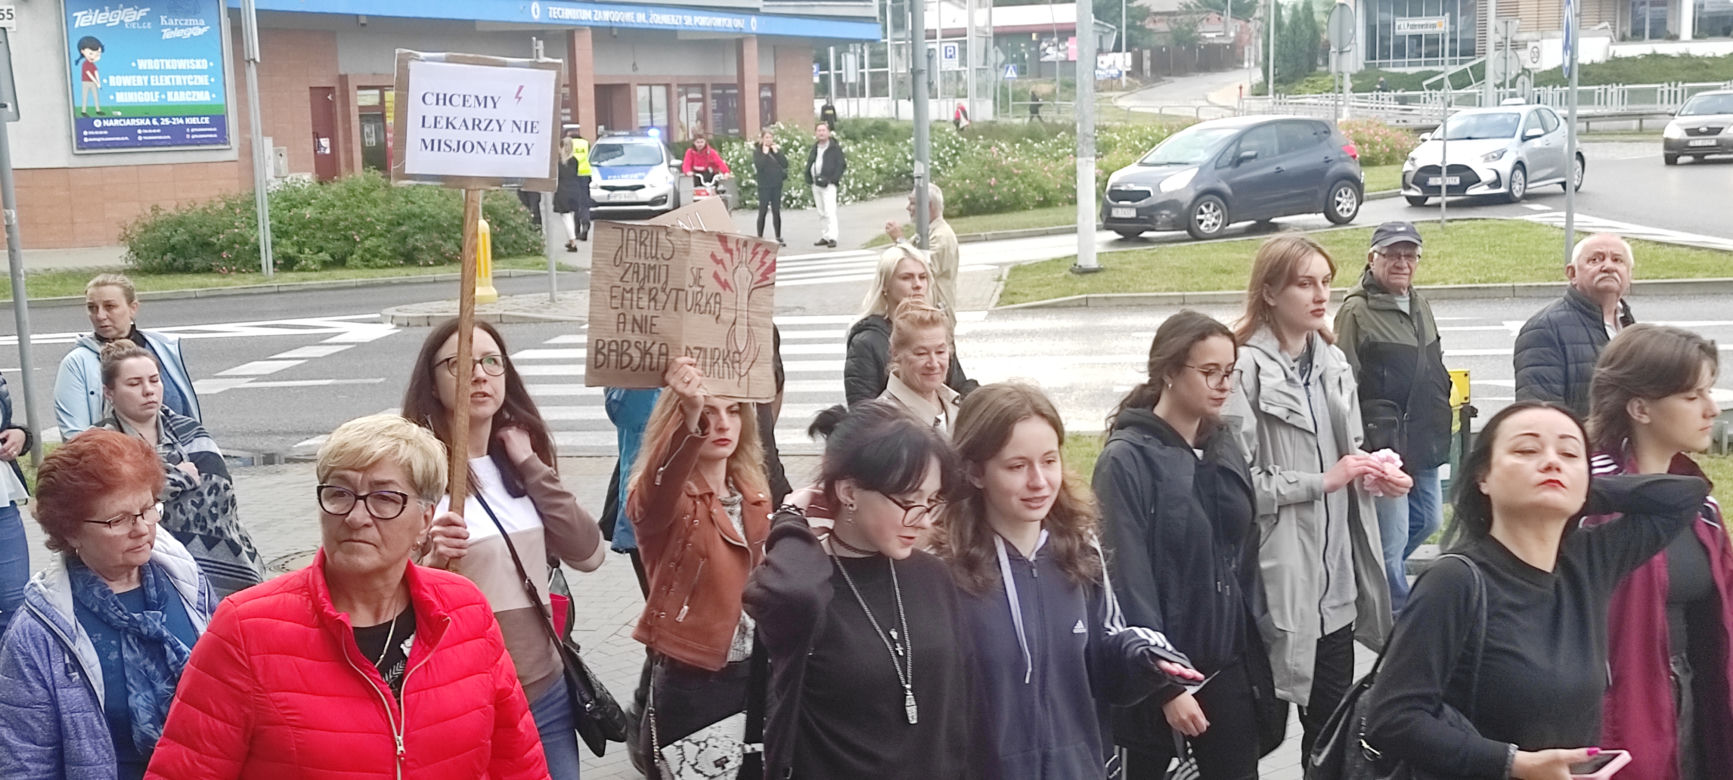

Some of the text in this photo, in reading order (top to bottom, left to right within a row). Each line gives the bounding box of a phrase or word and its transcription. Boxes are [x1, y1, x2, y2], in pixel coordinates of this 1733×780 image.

[72, 6, 150, 28] Telegraf
[160, 15, 205, 26] Karczma
[548, 7, 592, 20] TECHNIKUM
[593, 9, 635, 22] ZAWODOWE
[161, 26, 211, 40] Telegraf
[137, 59, 208, 70] WROTKOWISKO
[109, 75, 209, 86] ROWERY ELEKTRYCZNE
[115, 91, 211, 102] MINIGOLF KARCZMA
[421, 91, 501, 109] CHCEMY
[103, 118, 151, 127] NARCIARSKA
[185, 117, 210, 125] KIELCE
[420, 115, 540, 134] LEKARZY NIE
[419, 138, 535, 156] MISJONARZY
[619, 262, 670, 291] ZAJMIJ
[609, 285, 722, 323] EMERYTURKĄ
[616, 312, 661, 335] A NIE
[593, 338, 670, 372] BABSKA
